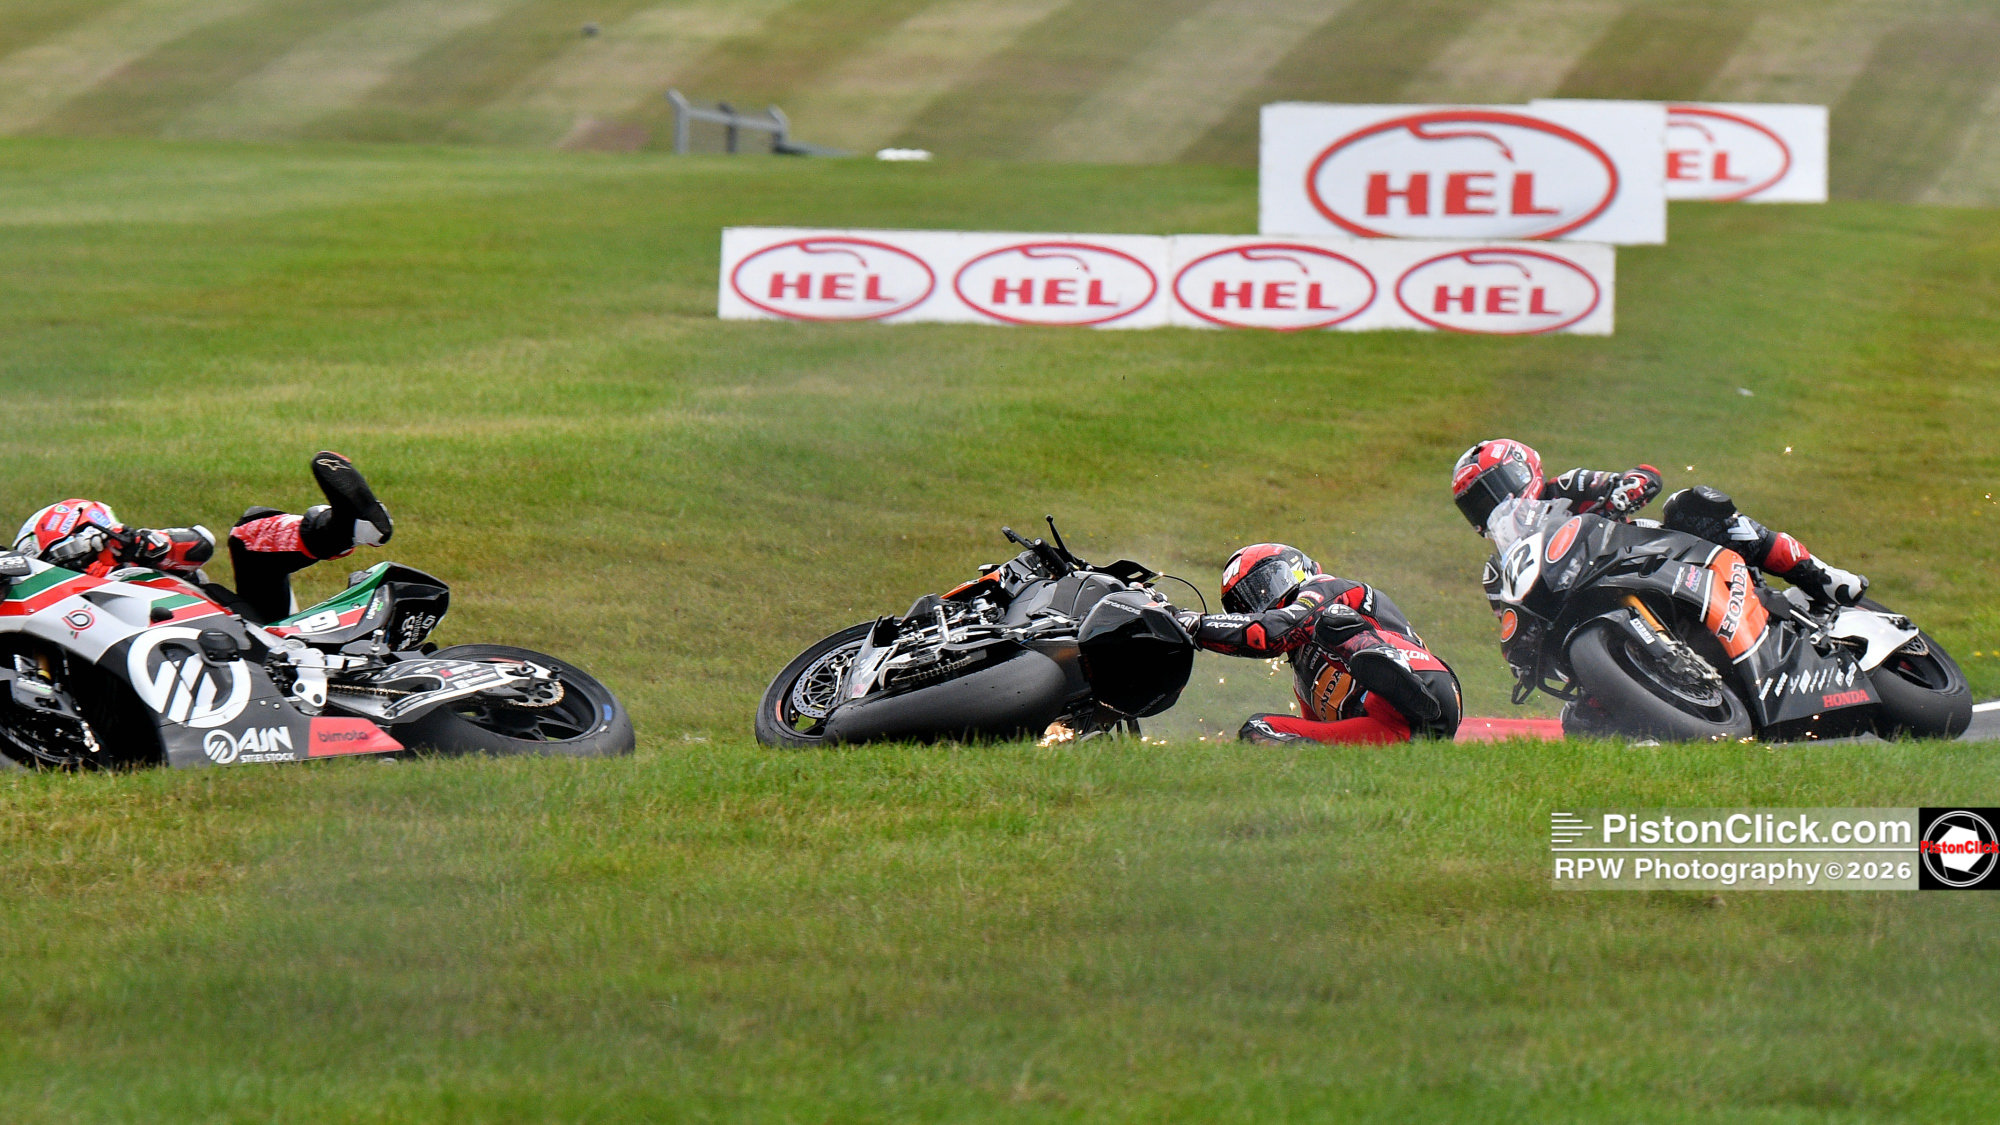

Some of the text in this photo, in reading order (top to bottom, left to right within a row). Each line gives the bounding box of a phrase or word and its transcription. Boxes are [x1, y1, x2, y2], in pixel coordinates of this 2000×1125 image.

[1666, 150, 1747, 182] EL
[1364, 171, 1560, 217] HEL
[768, 272, 896, 302] HEL
[991, 277, 1119, 307] HEL
[1211, 280, 1339, 310] HEL
[1433, 285, 1562, 316] HEL
[1503, 542, 1535, 598] 22
[1716, 562, 1749, 642] HONDA
[1822, 688, 1870, 708] HONDA
[237, 726, 294, 752] AJN
[318, 730, 369, 743] bimota
